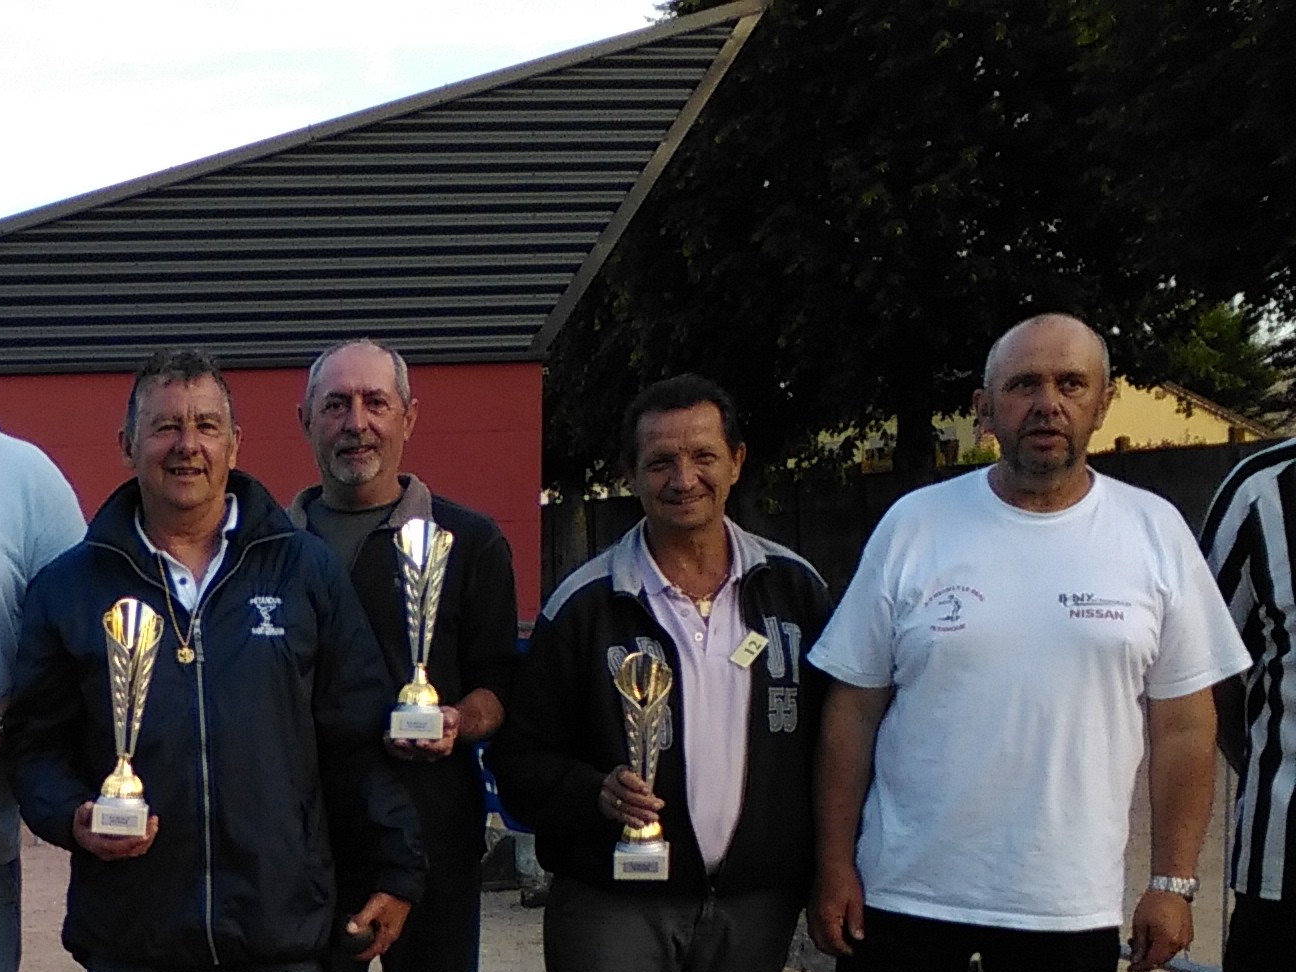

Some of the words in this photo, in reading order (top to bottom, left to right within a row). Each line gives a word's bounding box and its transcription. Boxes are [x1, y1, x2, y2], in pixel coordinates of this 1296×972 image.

[1069, 609, 1124, 620] NISSAN
[744, 640, 762, 655] 12
[768, 687, 798, 733] 55
